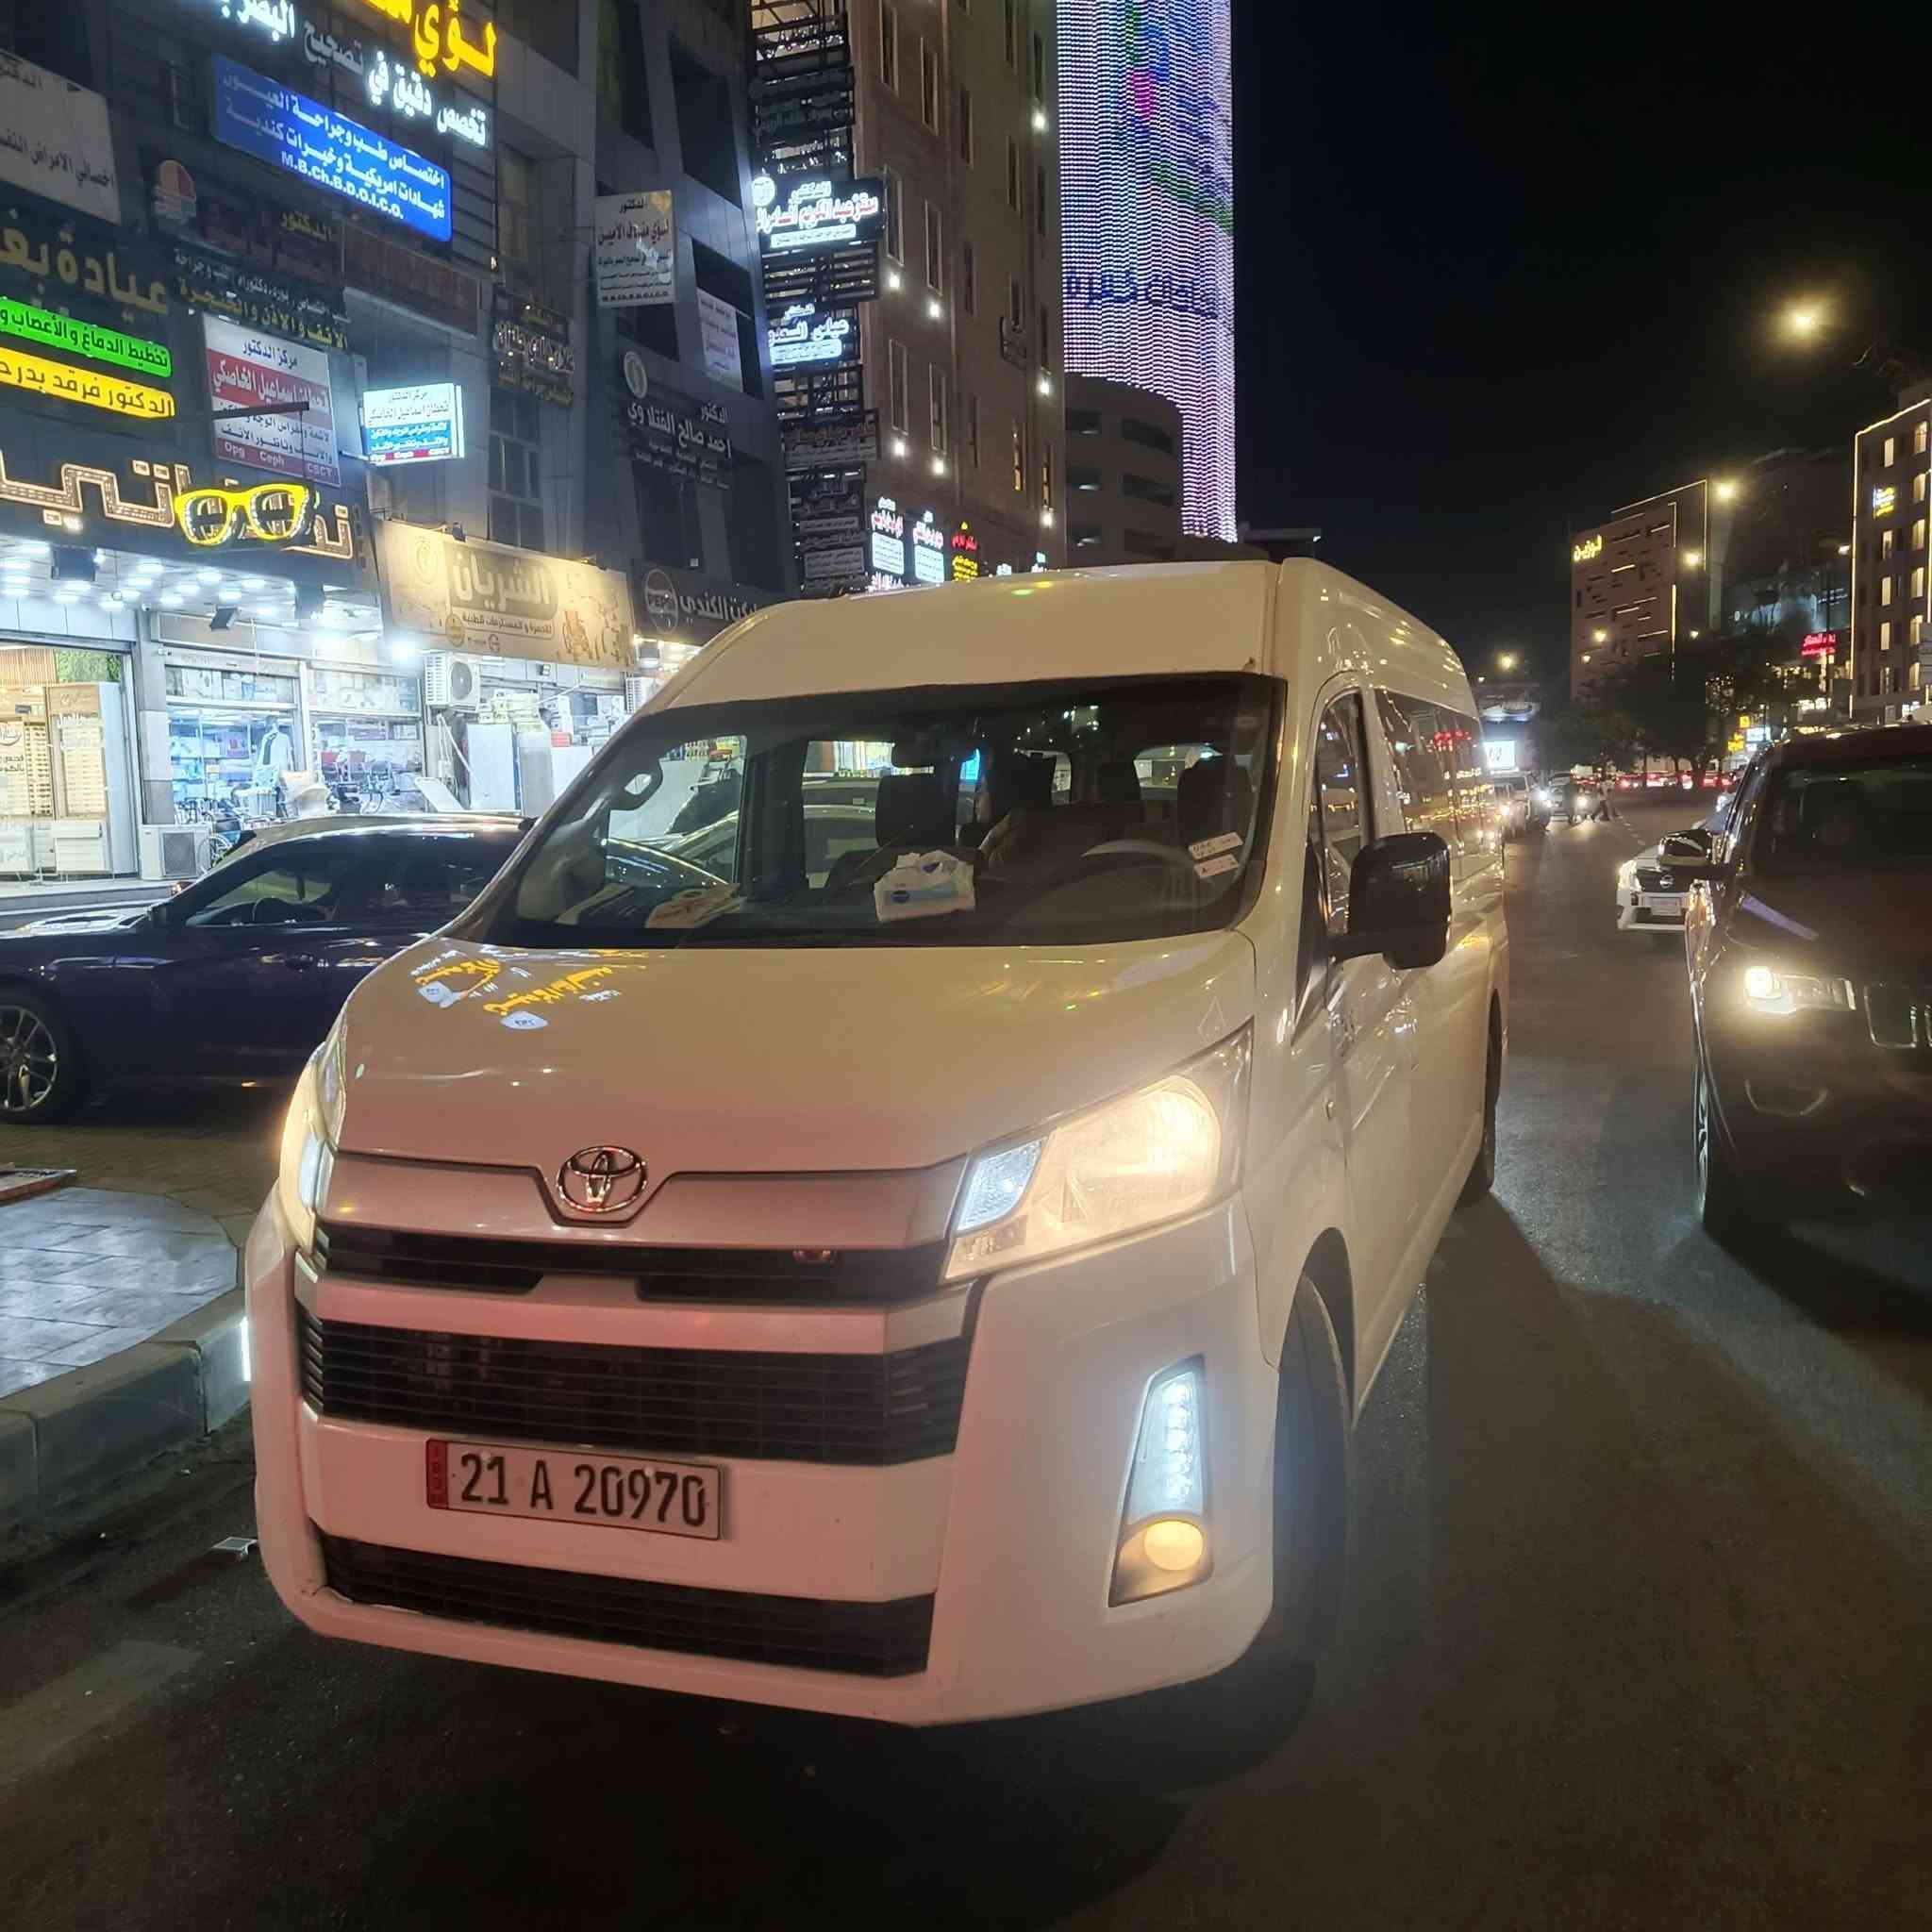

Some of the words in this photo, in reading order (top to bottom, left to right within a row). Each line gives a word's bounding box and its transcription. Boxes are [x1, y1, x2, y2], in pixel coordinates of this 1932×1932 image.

[367, 50, 390, 107] في
[391, 62, 433, 118] دقيق
[436, 107, 488, 147] تخصص
[57, 227, 170, 324] عيادة
[82, 325, 125, 356] الدماغ
[128, 339, 169, 368] تخطيط
[242, 339, 275, 359] الدكتور
[277, 347, 298, 370] مركز
[17, 365, 45, 390] بدر
[53, 369, 101, 400] فرقد
[108, 385, 174, 418] الدكتور
[678, 419, 705, 448] صالح
[225, 441, 245, 459] Opg
[453, 551, 551, 613] الشريان
[460, 1453, 509, 1506] 21
[529, 1459, 554, 1510] A
[574, 1463, 707, 1527] 20970
